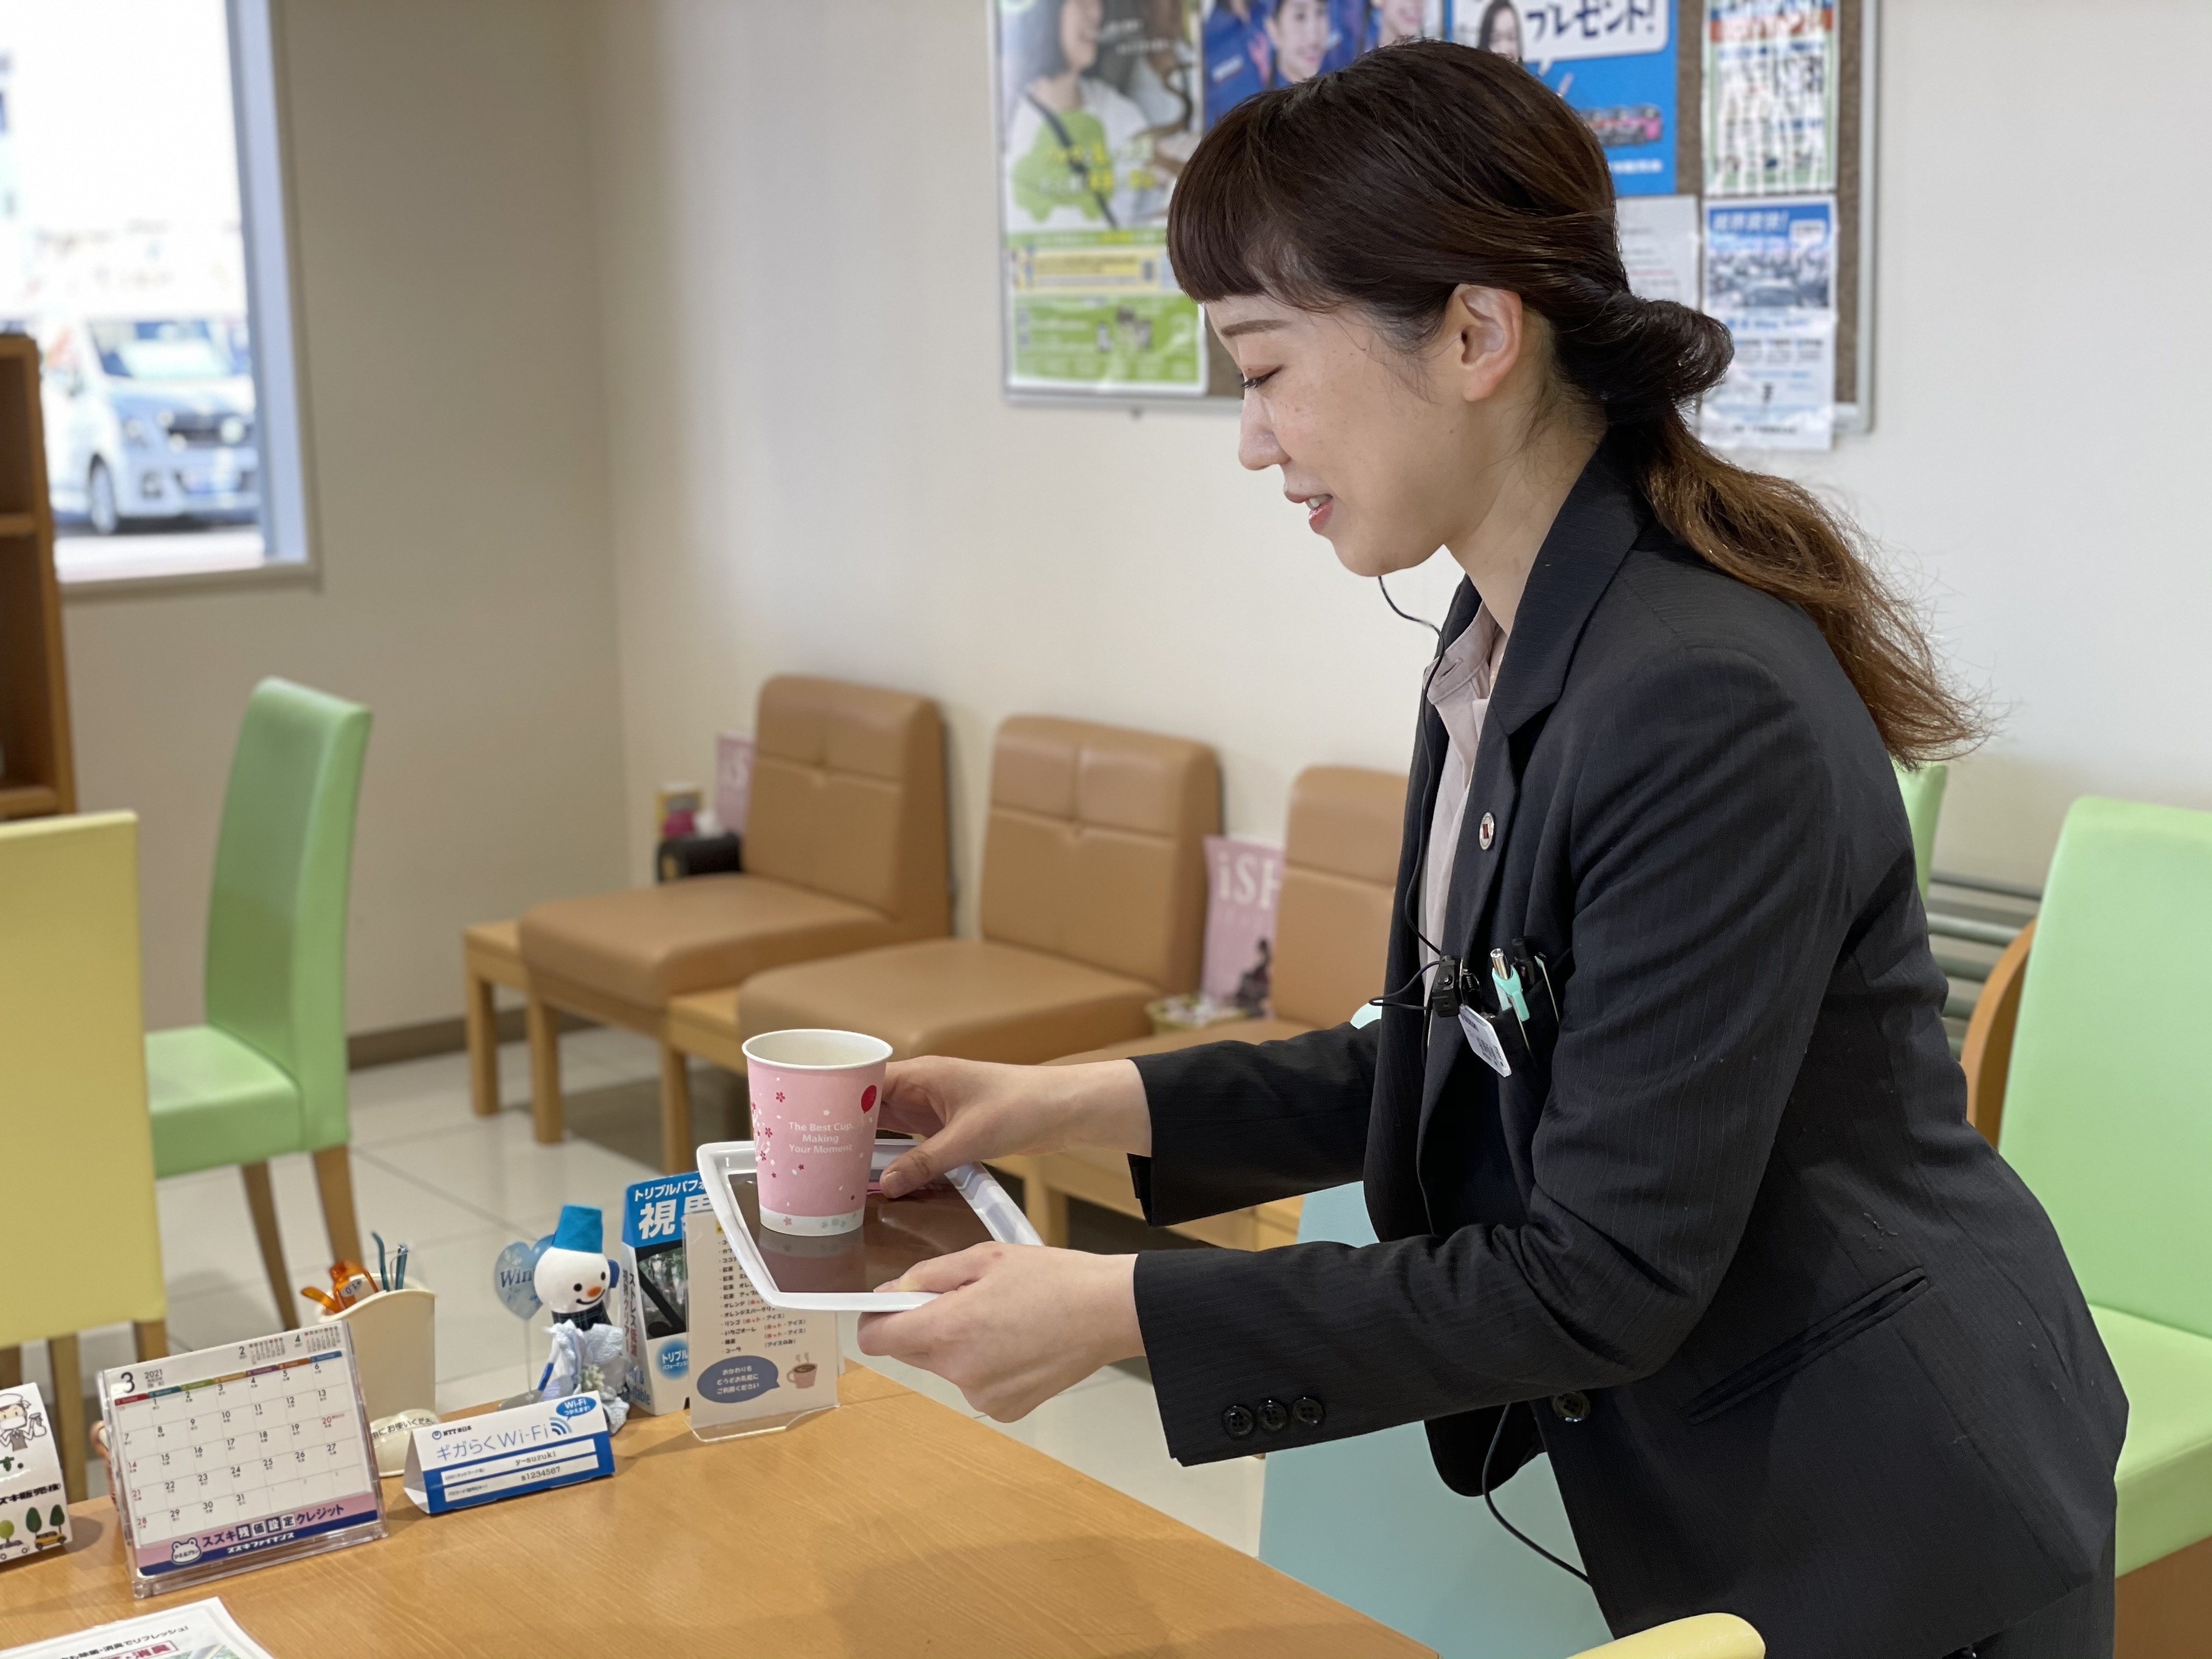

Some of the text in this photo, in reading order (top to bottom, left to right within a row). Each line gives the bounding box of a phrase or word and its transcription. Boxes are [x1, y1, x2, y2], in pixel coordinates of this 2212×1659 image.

[788, 1122, 807, 1131] The
[810, 1123, 832, 1131] Best
[802, 1134, 839, 1144] Making
[789, 1144, 853, 1153] Your Moment
[635, 1180, 706, 1201] トリプルパフォ
[500, 1268, 534, 1288] Win
[239, 1346, 245, 1355] 2
[722, 1365, 753, 1375] おかわりも
[121, 1372, 135, 1393] 3
[144, 1369, 163, 1380] 2021
[716, 1383, 760, 1395] ご利用ください
[565, 1398, 586, 1409] Wi-Fi
[516, 1450, 557, 1466] y-suzuki
[165, 1481, 174, 1489] 22
[198, 1474, 208, 1482] 23
[230, 1466, 241, 1474] 24
[263, 1458, 273, 1466] 25
[295, 1451, 305, 1459] 26
[327, 1443, 336, 1452] 27
[521, 1466, 561, 1481] s1234567
[137, 1517, 146, 1526] 28
[170, 1509, 180, 1517] 29
[203, 1501, 213, 1510] 30
[227, 1532, 295, 1554] スズキファイナンス
